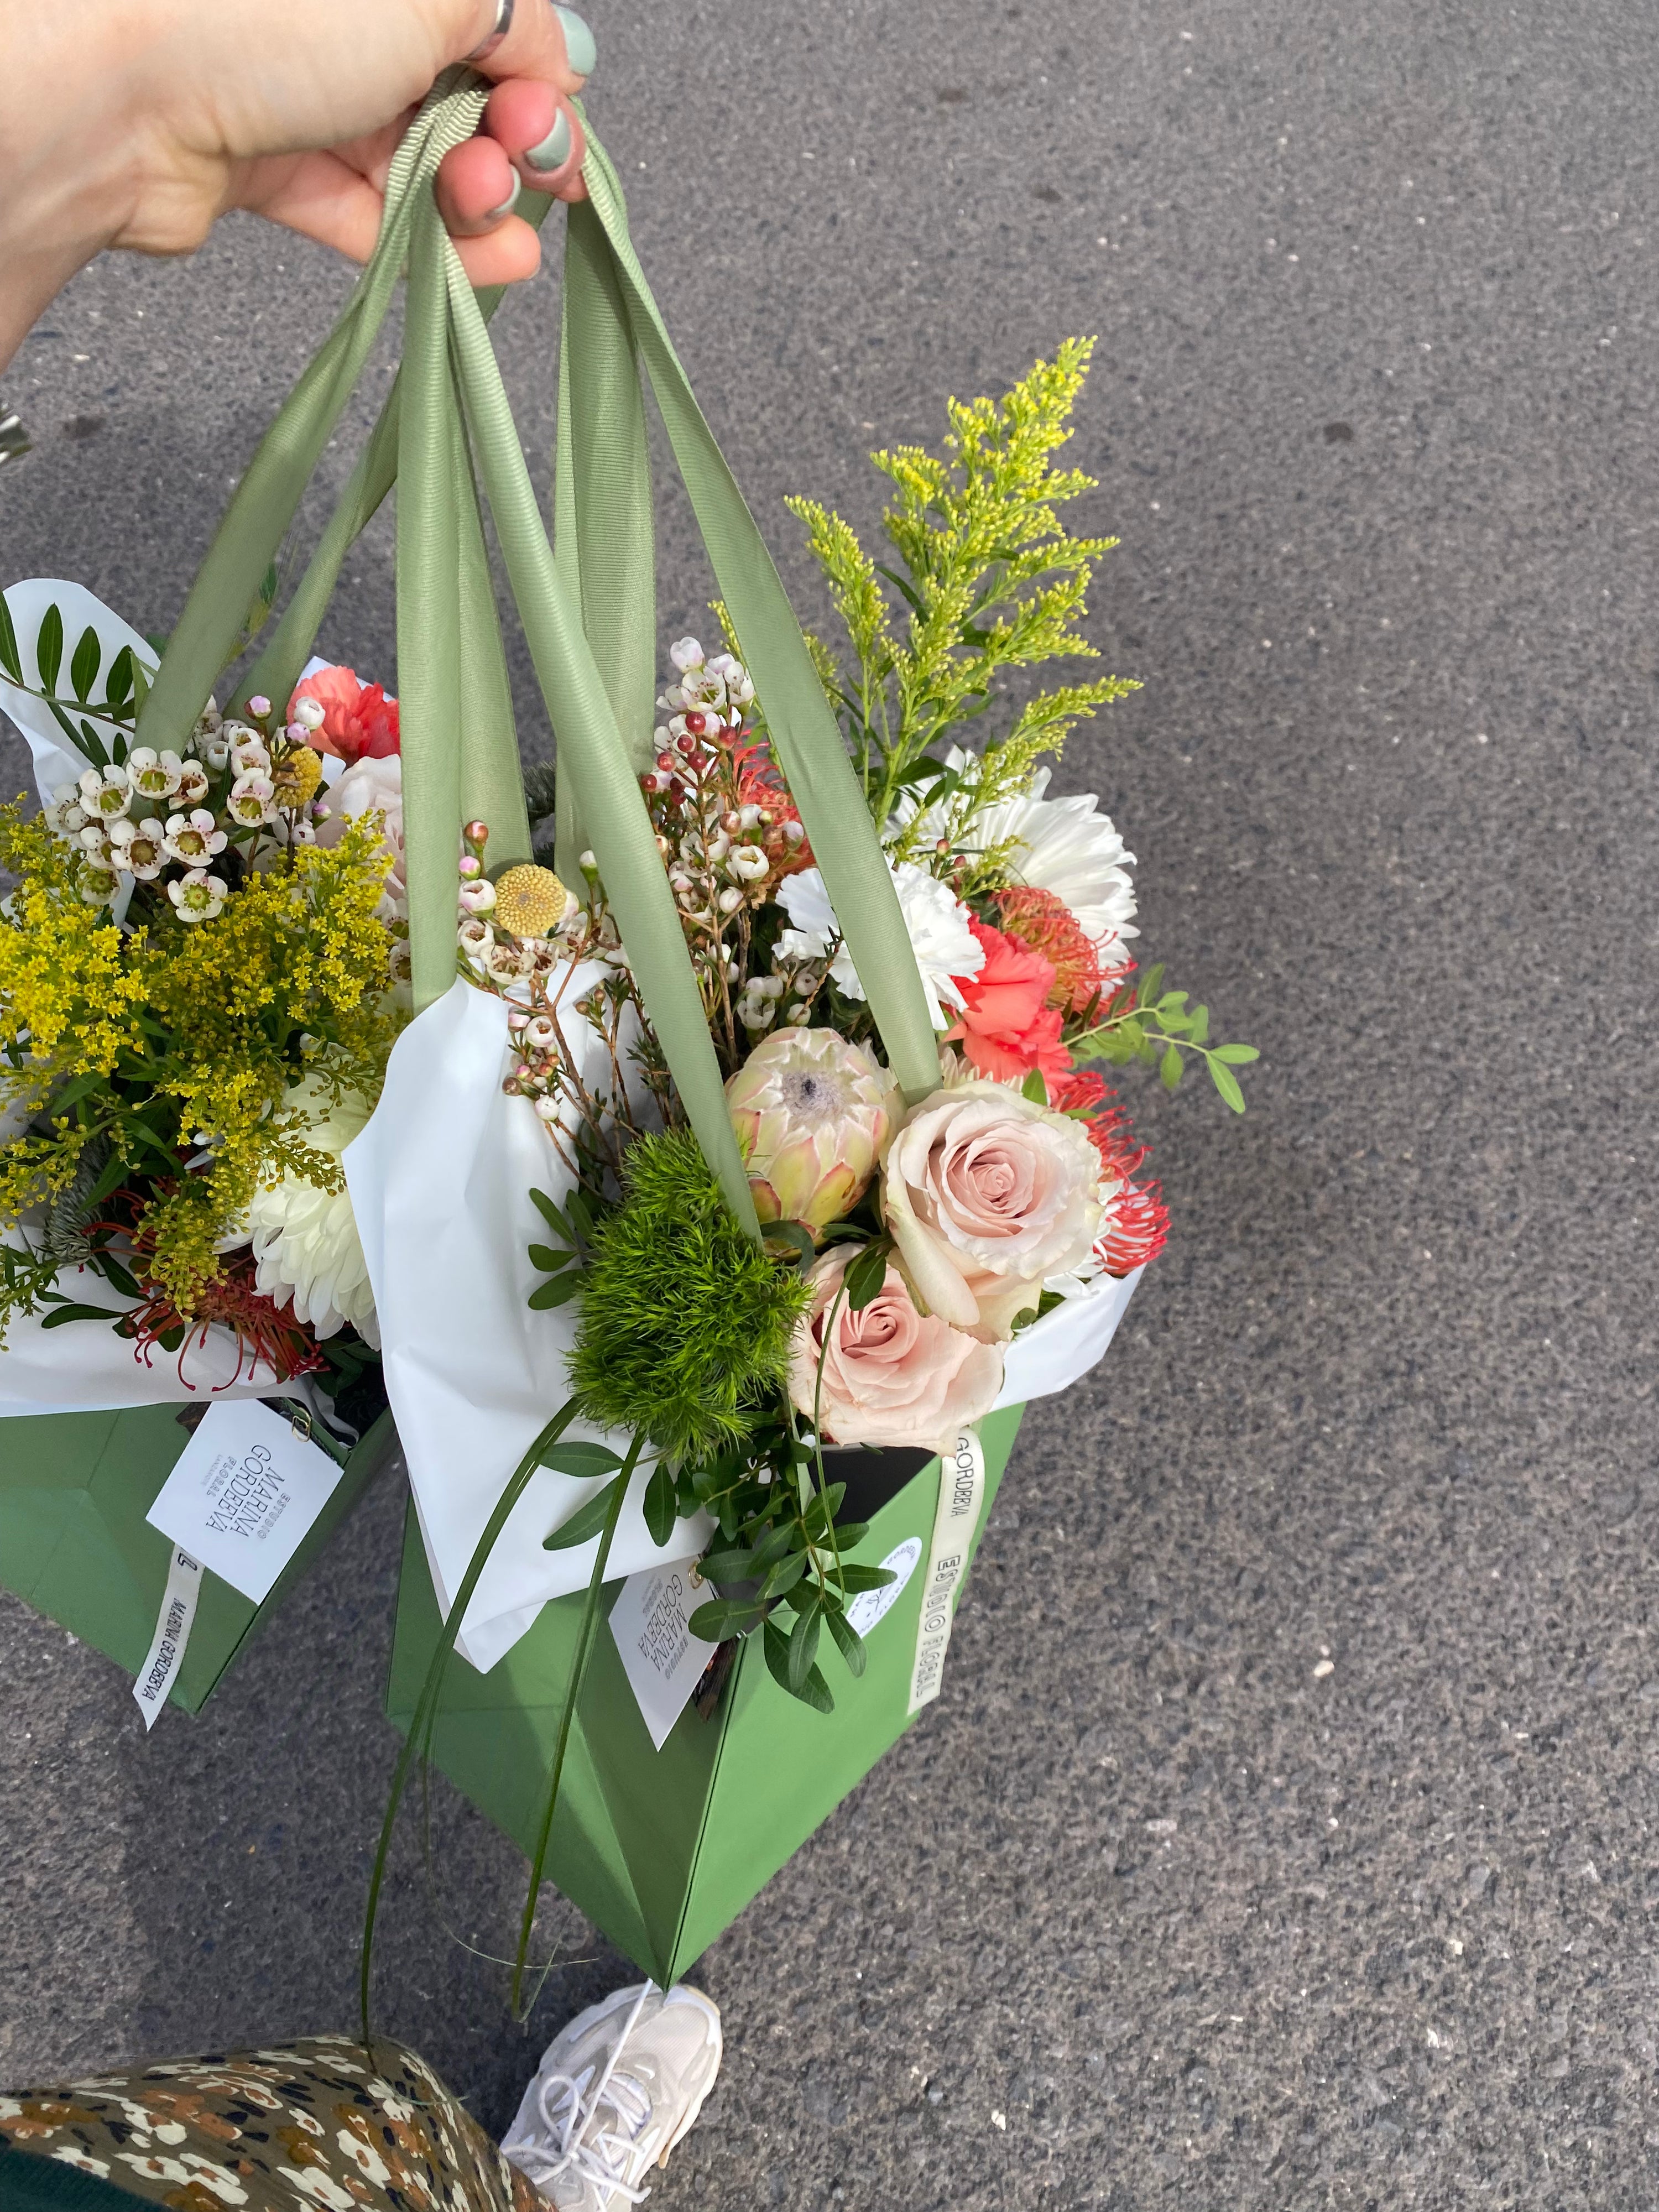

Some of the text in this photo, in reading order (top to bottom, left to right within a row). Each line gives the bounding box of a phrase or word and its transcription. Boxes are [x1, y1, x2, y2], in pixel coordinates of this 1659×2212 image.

[206, 1455, 237, 1497] FLORAL
[206, 1444, 272, 1532] GORDEEVA
[230, 1466, 285, 1537] MARINA
[951, 1437, 974, 1517] GORDEEVA
[257, 1493, 291, 1540] ESTUDIO
[638, 1574, 682, 1658] GORDEEVA
[925, 1555, 961, 1632] ESTUDIO
[142, 1597, 187, 1700] MARINA GORDEEVA
[651, 1603, 687, 1672] MARINA
